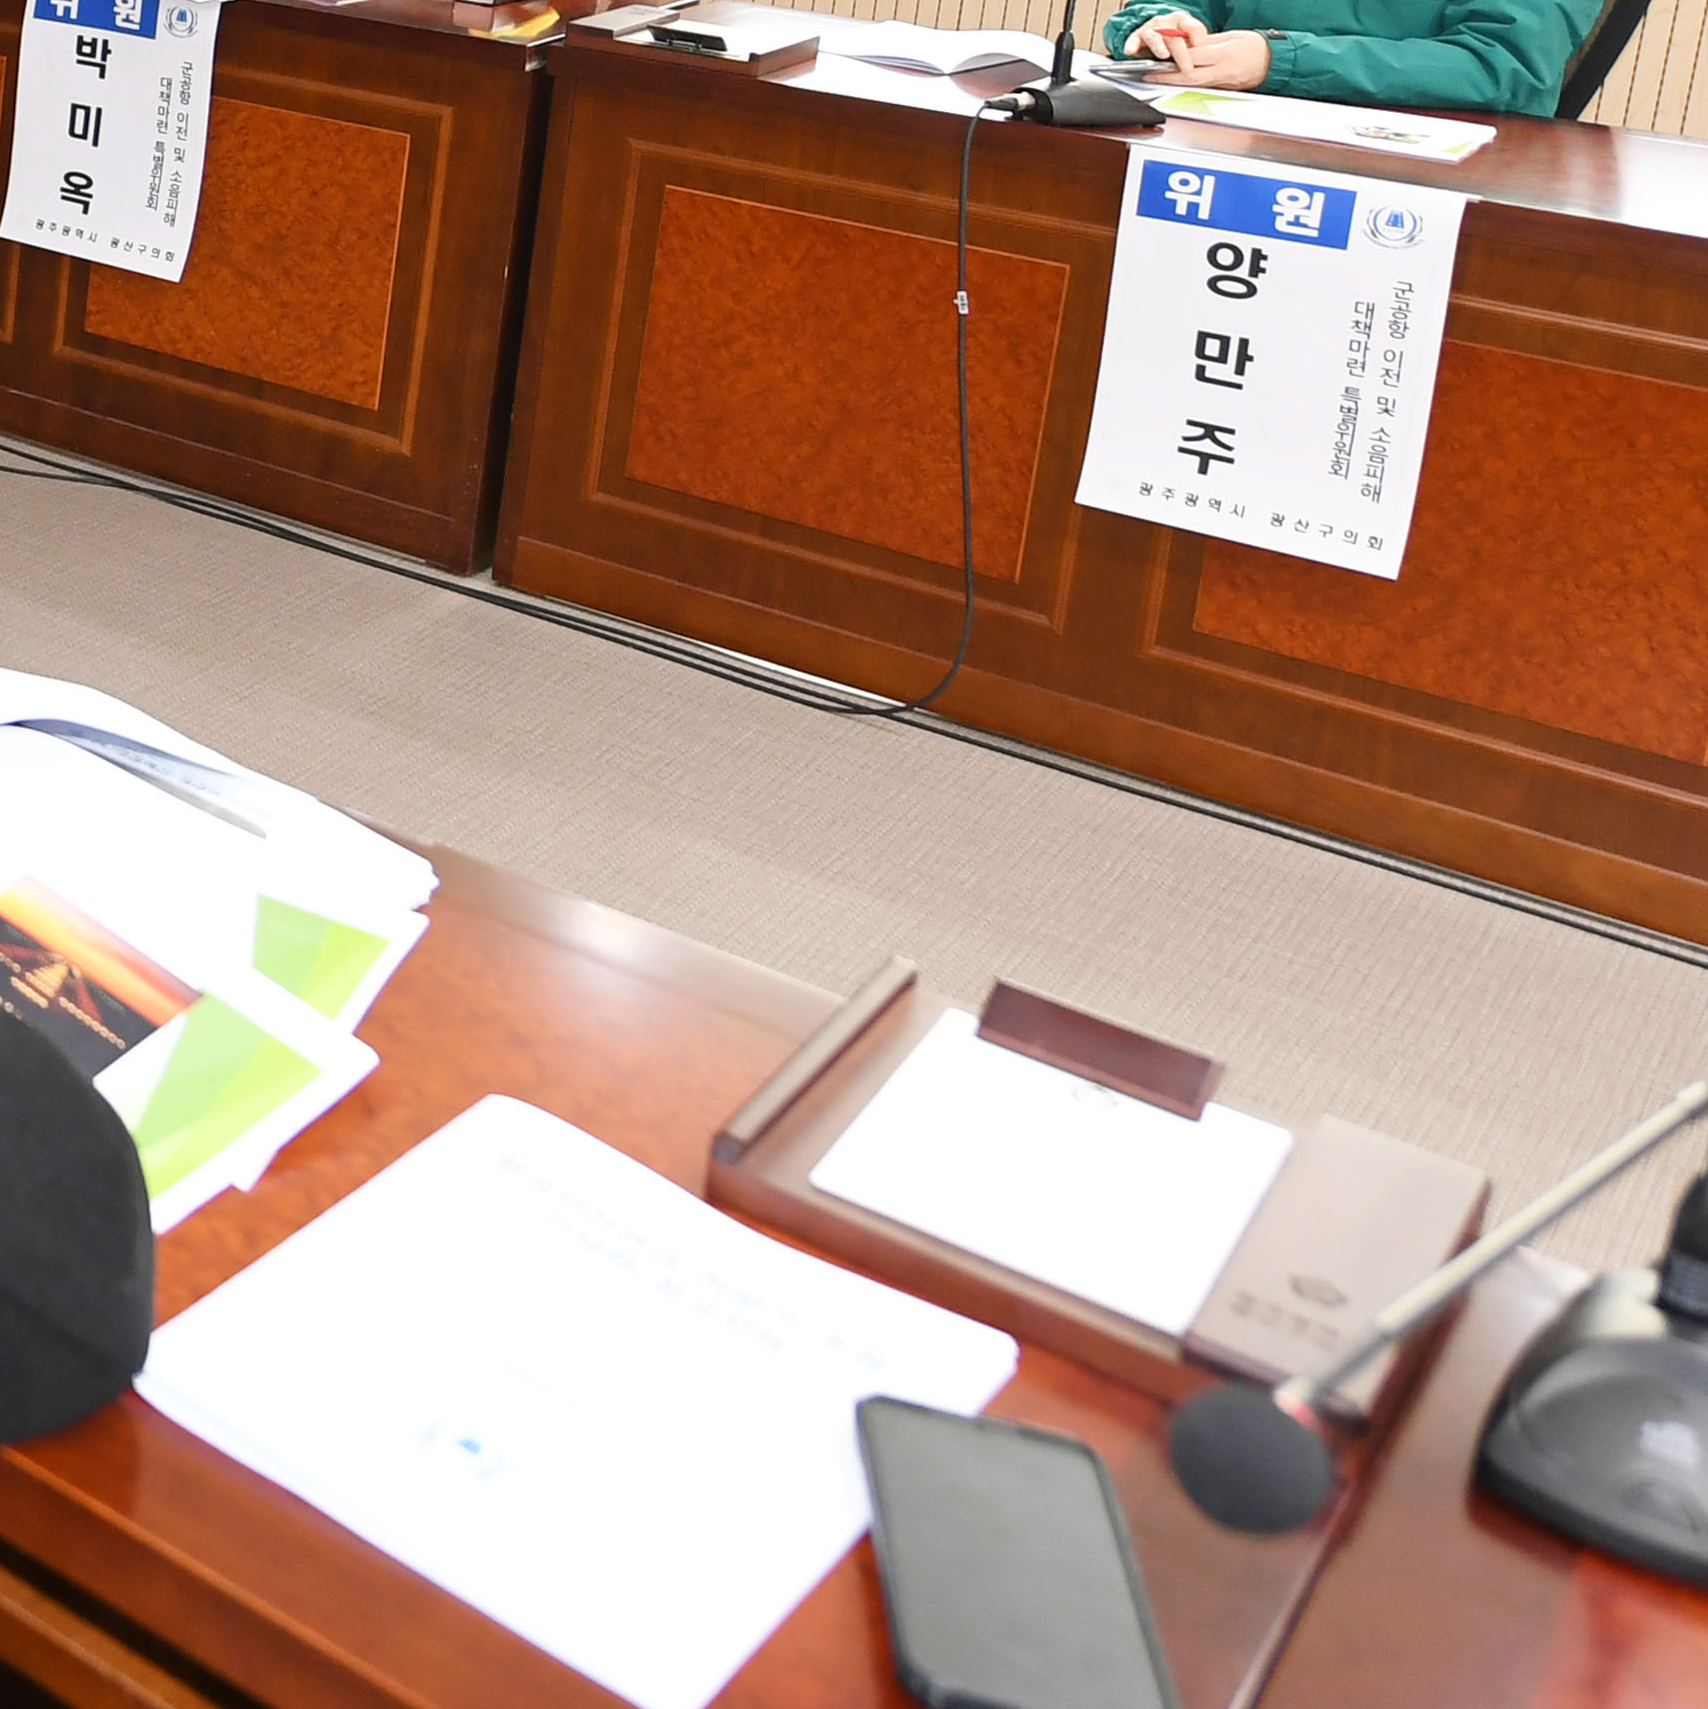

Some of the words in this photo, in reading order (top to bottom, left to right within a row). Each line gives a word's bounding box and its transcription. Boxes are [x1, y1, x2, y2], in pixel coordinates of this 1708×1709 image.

[1345, 300, 1376, 378] 대책마련
[1389, 280, 1415, 341] 군공항
[1379, 348, 1404, 389] 이전
[1327, 386, 1362, 481] 특별위원회
[1375, 398, 1397, 418] 및
[1360, 426, 1392, 504] 소음피해
[1137, 480, 1247, 520] 광주광역시
[1270, 512, 1385, 552] 광산구의회
